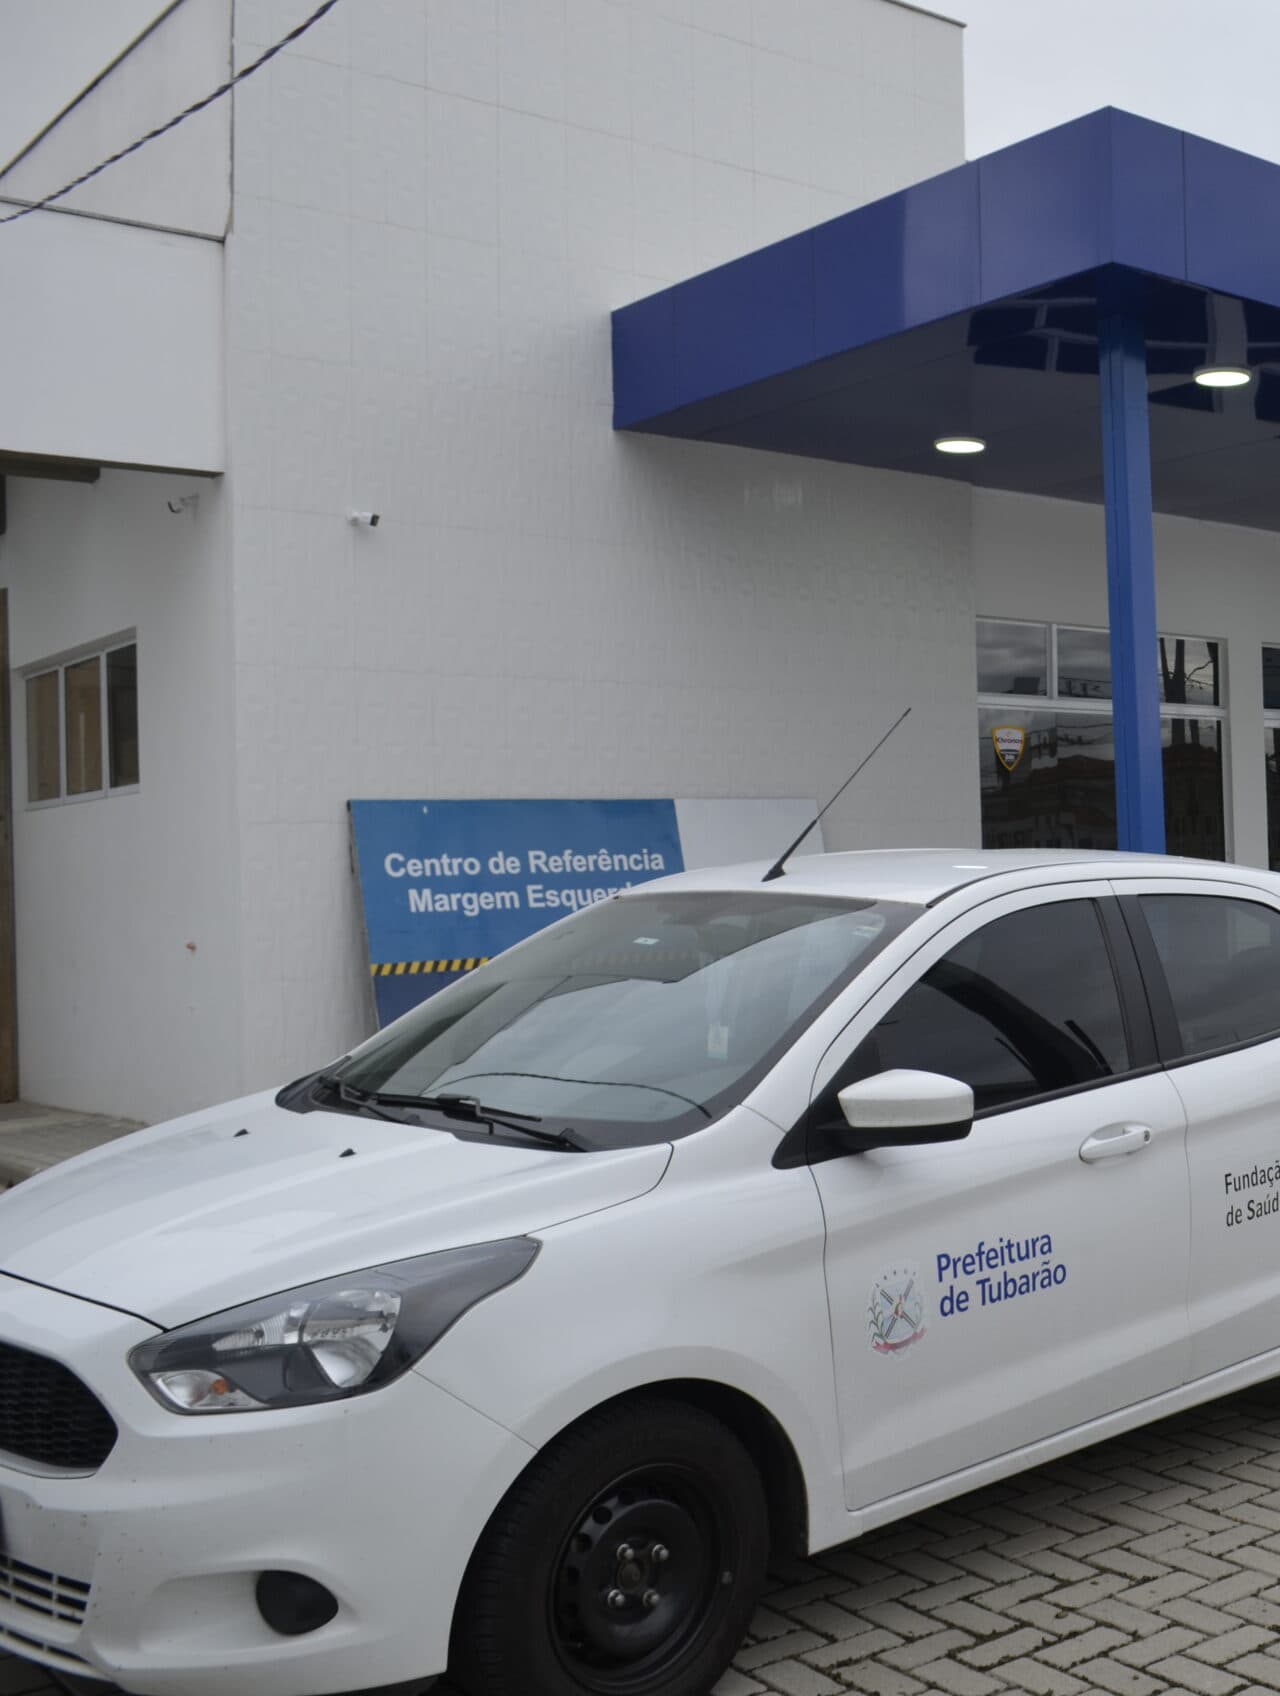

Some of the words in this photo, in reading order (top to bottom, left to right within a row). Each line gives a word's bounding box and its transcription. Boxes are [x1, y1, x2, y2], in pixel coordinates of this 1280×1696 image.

[384, 852, 481, 878] Centro
[488, 851, 521, 875] de
[528, 848, 665, 874] Referência
[408, 887, 520, 917] Margem
[526, 881, 633, 911] Esque
[1226, 1204, 1242, 1227] de
[936, 1234, 1053, 1283] Prefeitura
[940, 1284, 969, 1317] de
[975, 1260, 1067, 1306] Tubarão
